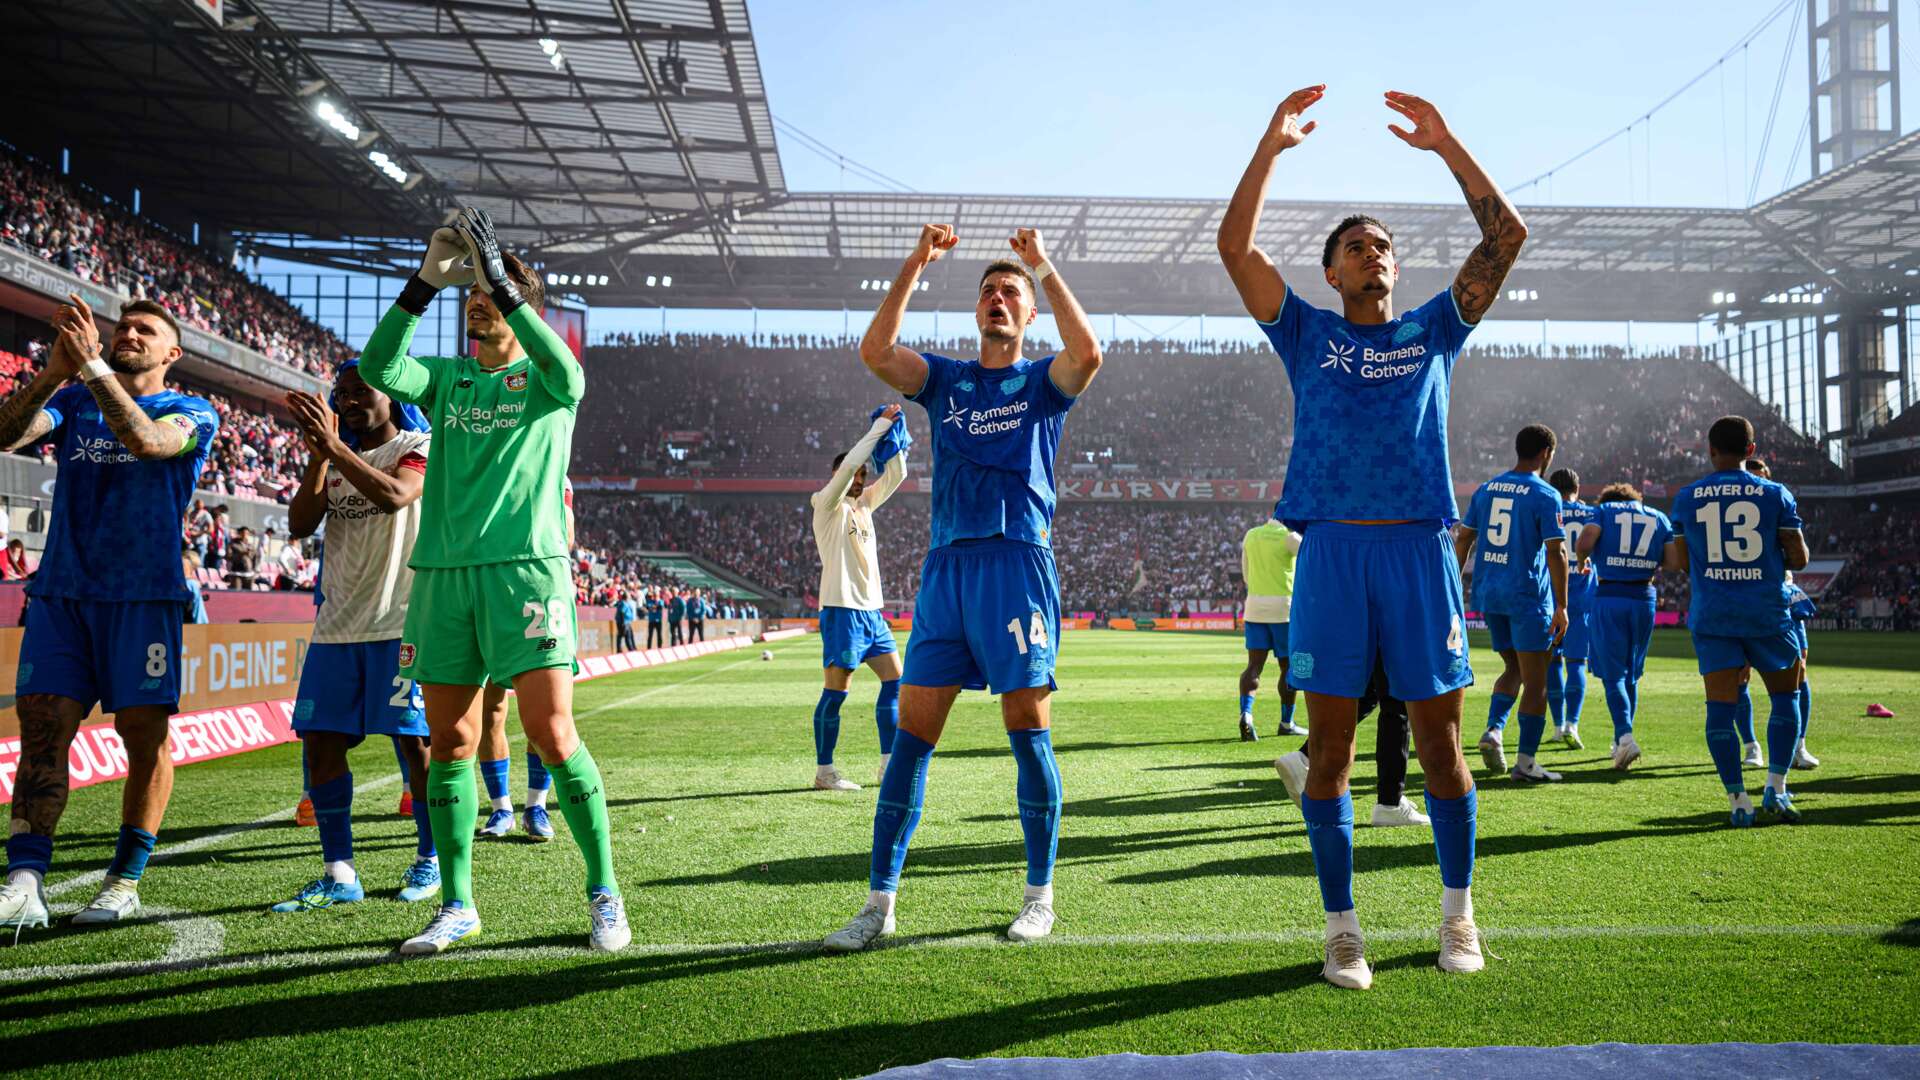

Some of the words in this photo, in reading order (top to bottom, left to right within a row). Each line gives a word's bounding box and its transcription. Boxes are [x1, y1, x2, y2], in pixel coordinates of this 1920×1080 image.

[1363, 343, 1427, 363] Barmenia
[1360, 361, 1421, 379] Gothaer
[970, 401, 1028, 423] Barmenia
[968, 417, 1022, 436] Gothaer
[1057, 481, 1214, 499] KURVE
[1487, 482, 1516, 493] BAYER
[1516, 486, 1531, 495] 04
[1694, 484, 1741, 498] BAYER
[1745, 485, 1764, 496] 04
[1487, 497, 1514, 547] 5
[1696, 501, 1763, 563] 13
[1615, 512, 1658, 556] 17
[1484, 552, 1509, 564] BADÉ
[1606, 556, 1626, 567] BEN
[1704, 567, 1763, 581] ARTHUR
[523, 598, 568, 639] 28
[1007, 611, 1048, 655] 14
[1447, 614, 1464, 657] 4
[537, 638, 558, 651] NB
[146, 643, 167, 677] 8
[209, 640, 286, 692] DEINE
